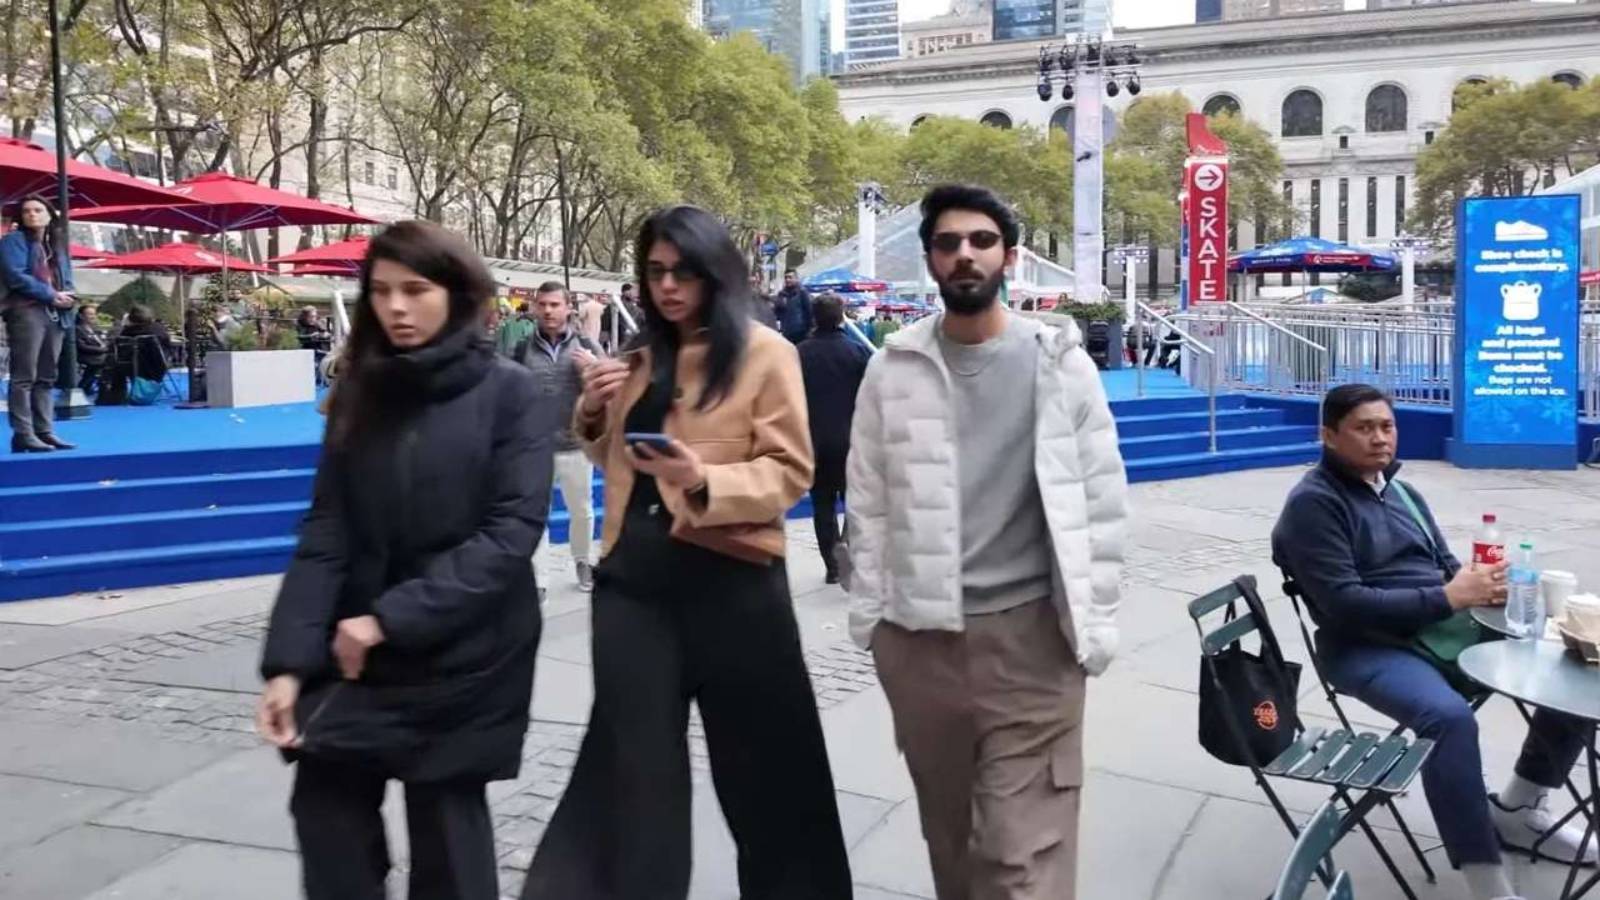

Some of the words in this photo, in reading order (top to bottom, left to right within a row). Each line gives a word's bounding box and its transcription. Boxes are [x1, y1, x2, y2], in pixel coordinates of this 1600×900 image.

[1198, 196, 1219, 300] SKATE
[1513, 249, 1550, 259] check
[1497, 325, 1514, 335] All
[1515, 325, 1545, 336] bags
[1546, 350, 1563, 360] be
[1488, 375, 1514, 385] Bags
[1534, 376, 1552, 384] not
[1474, 387, 1513, 395] allowed
[1529, 387, 1547, 395] the
